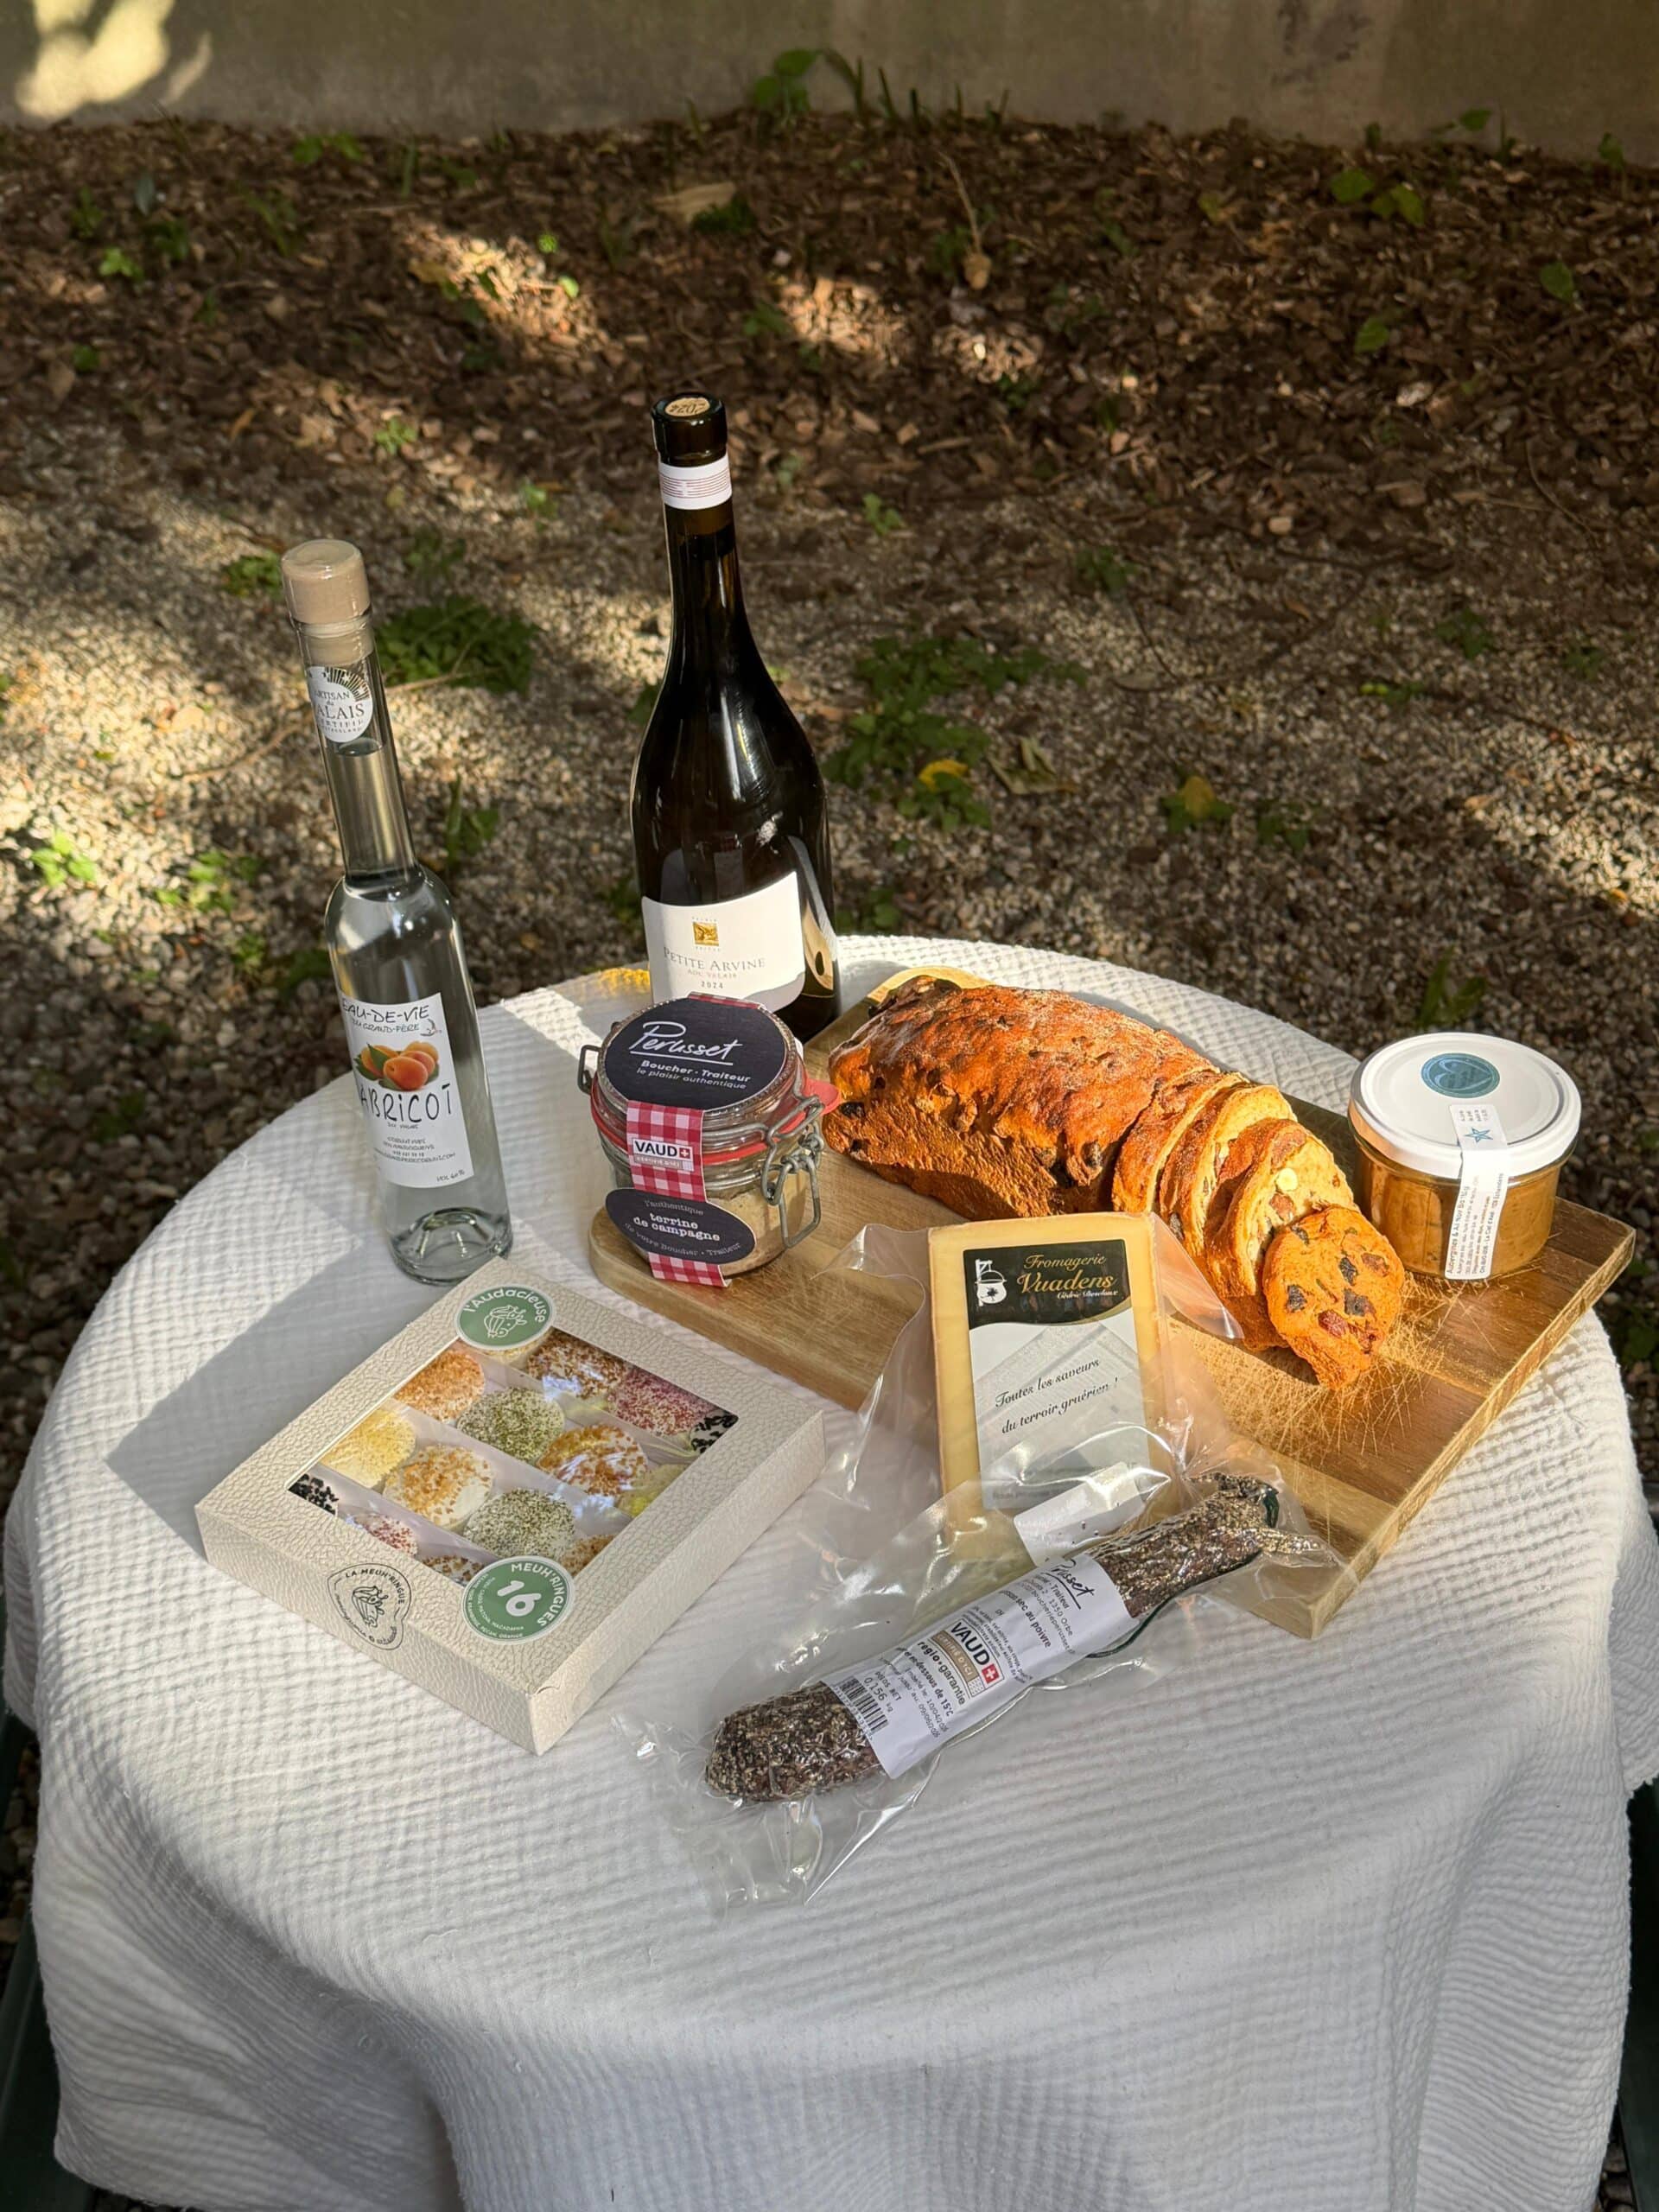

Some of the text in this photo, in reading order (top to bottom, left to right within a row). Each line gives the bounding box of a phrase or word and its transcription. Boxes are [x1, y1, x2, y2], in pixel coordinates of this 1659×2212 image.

[315, 702, 365, 720] ALAIS
[664, 946, 766, 971] PETITE ARVINE
[701, 981, 724, 989] 2024
[628, 1020, 743, 1060] Perusset
[640, 1059, 752, 1083] Boucher Traiteur
[648, 1068, 681, 1081] plaisir
[682, 1075, 747, 1090] authentique
[359, 1082, 452, 1123] ABRICOT
[634, 1141, 677, 1157] VAUD
[644, 1199, 704, 1217] l'authentique
[632, 1216, 721, 1242] de campagne
[649, 1212, 699, 1230] terrine
[706, 1242, 741, 1256] Traiteur
[1023, 1253, 1107, 1272] Fromagerie
[1016, 1269, 1118, 1294] Vuadens
[463, 1287, 547, 1323] l'Audacieuse
[995, 1358, 1101, 1408] Toutes les saveurs
[1001, 1419, 1018, 1434] du
[1020, 1403, 1059, 1427] terroir
[1058, 1383, 1109, 1416] gruérien
[345, 1568, 405, 1605] LA MEUH'RINGUE
[497, 1580, 543, 1618] 16
[511, 1561, 566, 1627] MEUH'RINGUES
[1050, 1584, 1070, 1609] Traiteur
[1025, 1610, 1036, 1621] au
[950, 1621, 991, 1667] VAUD
[1030, 1621, 1053, 1648] poivre
[863, 1676, 887, 1701] 0,156
[933, 1687, 945, 1699] de
[939, 1698, 956, 1717] 15°C
